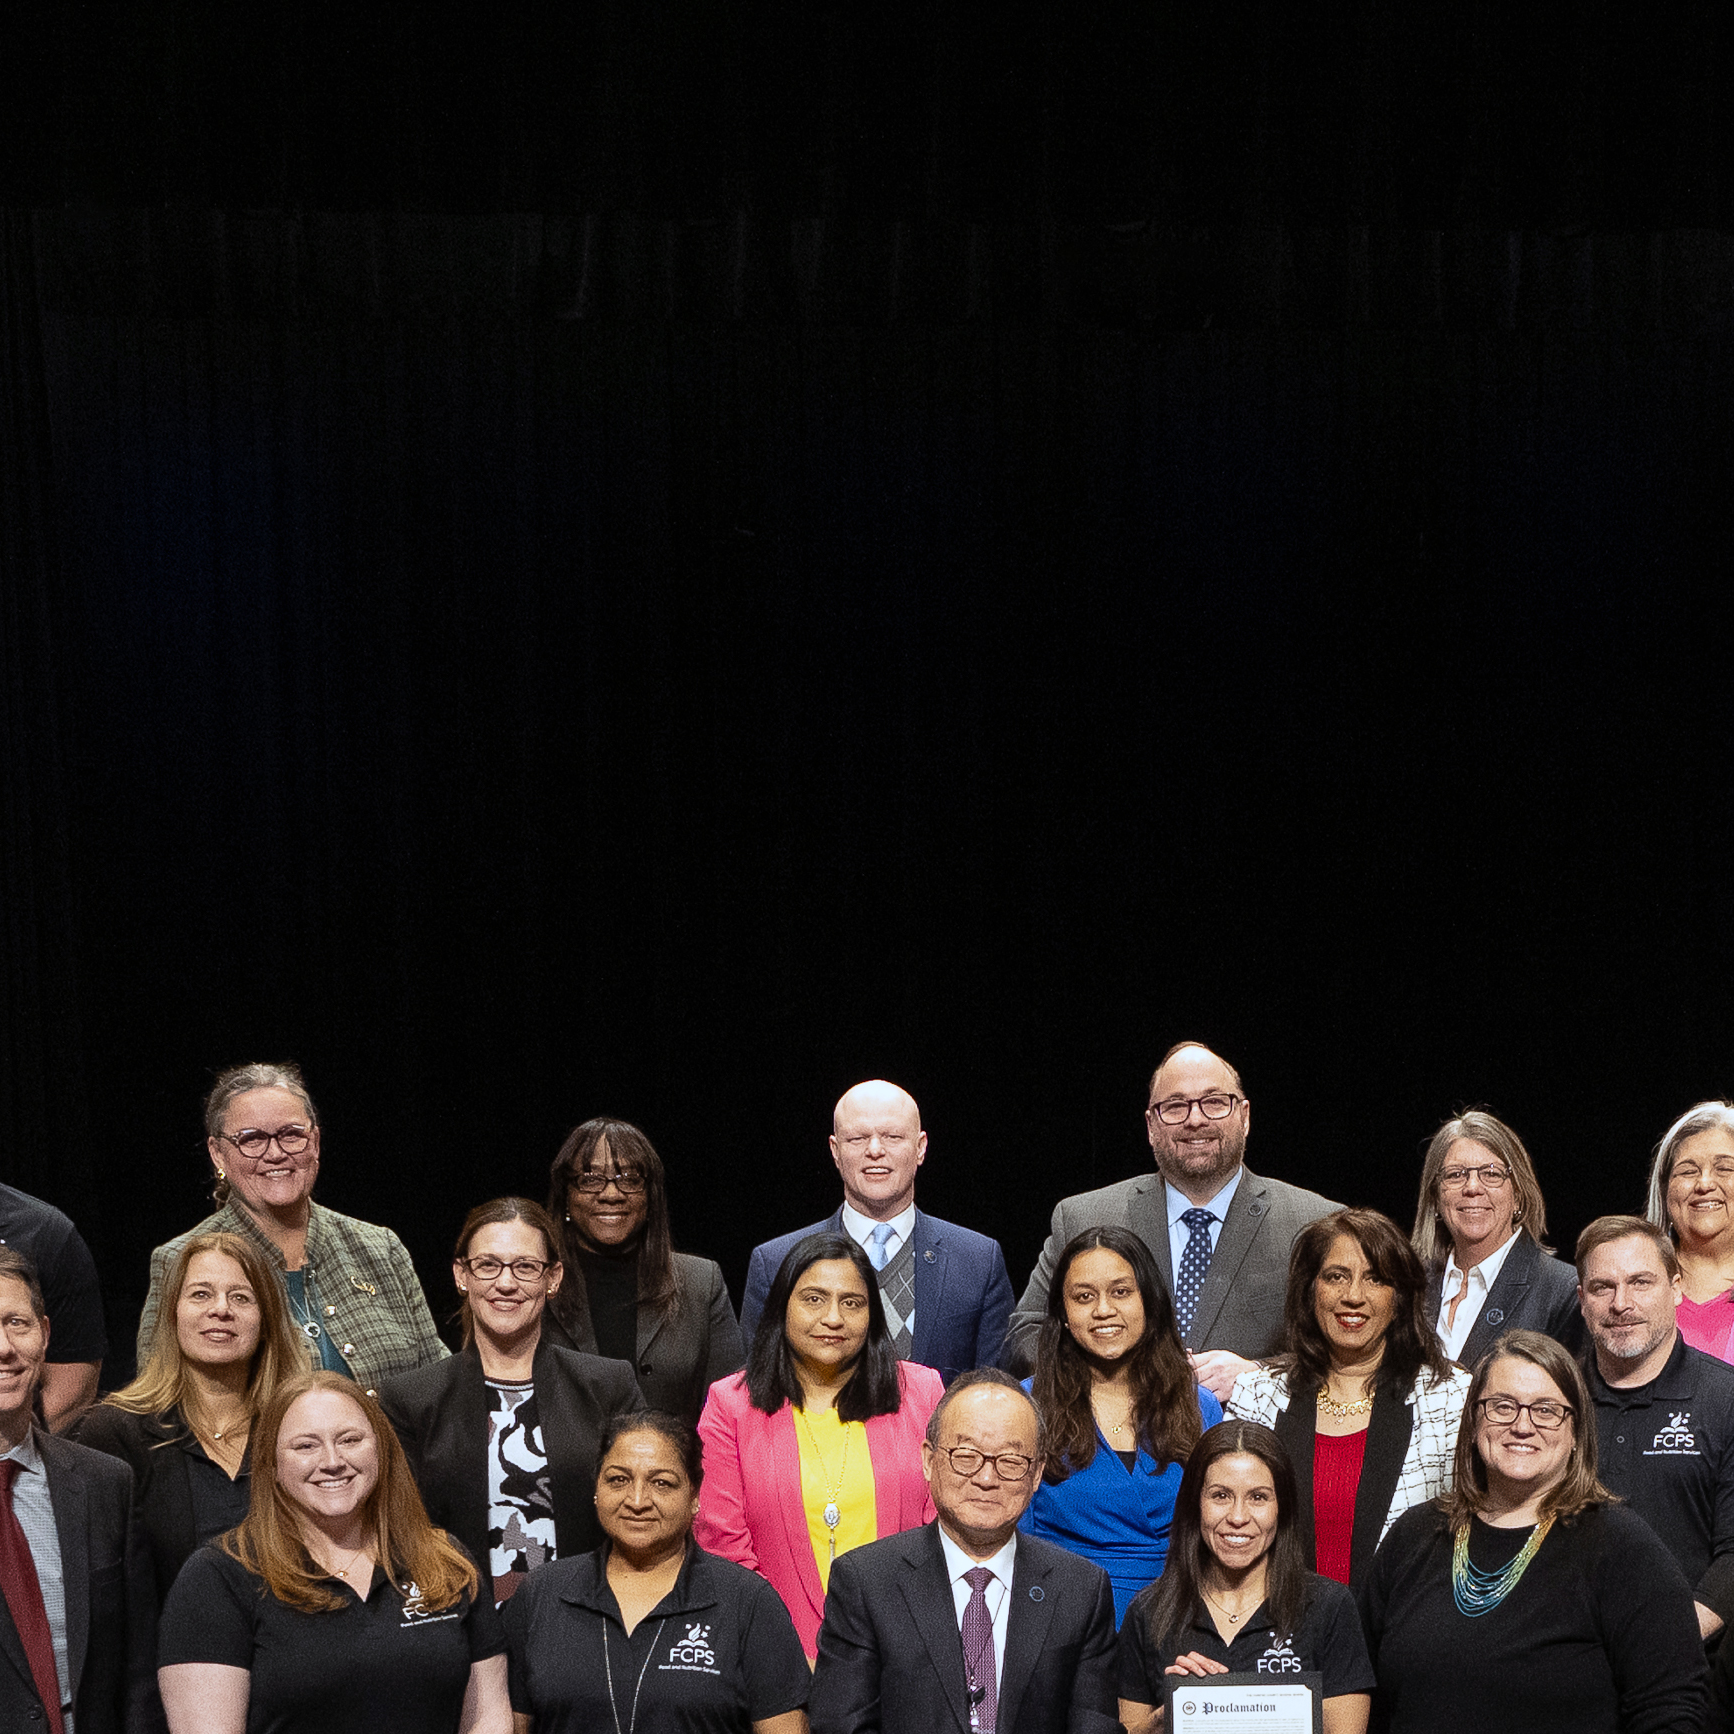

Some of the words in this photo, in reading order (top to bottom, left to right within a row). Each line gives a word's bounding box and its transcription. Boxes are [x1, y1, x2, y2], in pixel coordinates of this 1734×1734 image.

[1653, 1433, 1695, 1448] FCPS
[669, 1647, 715, 1666] FCPS
[1257, 1656, 1302, 1674] FCPS
[1202, 1700, 1277, 1715] Proclamation
